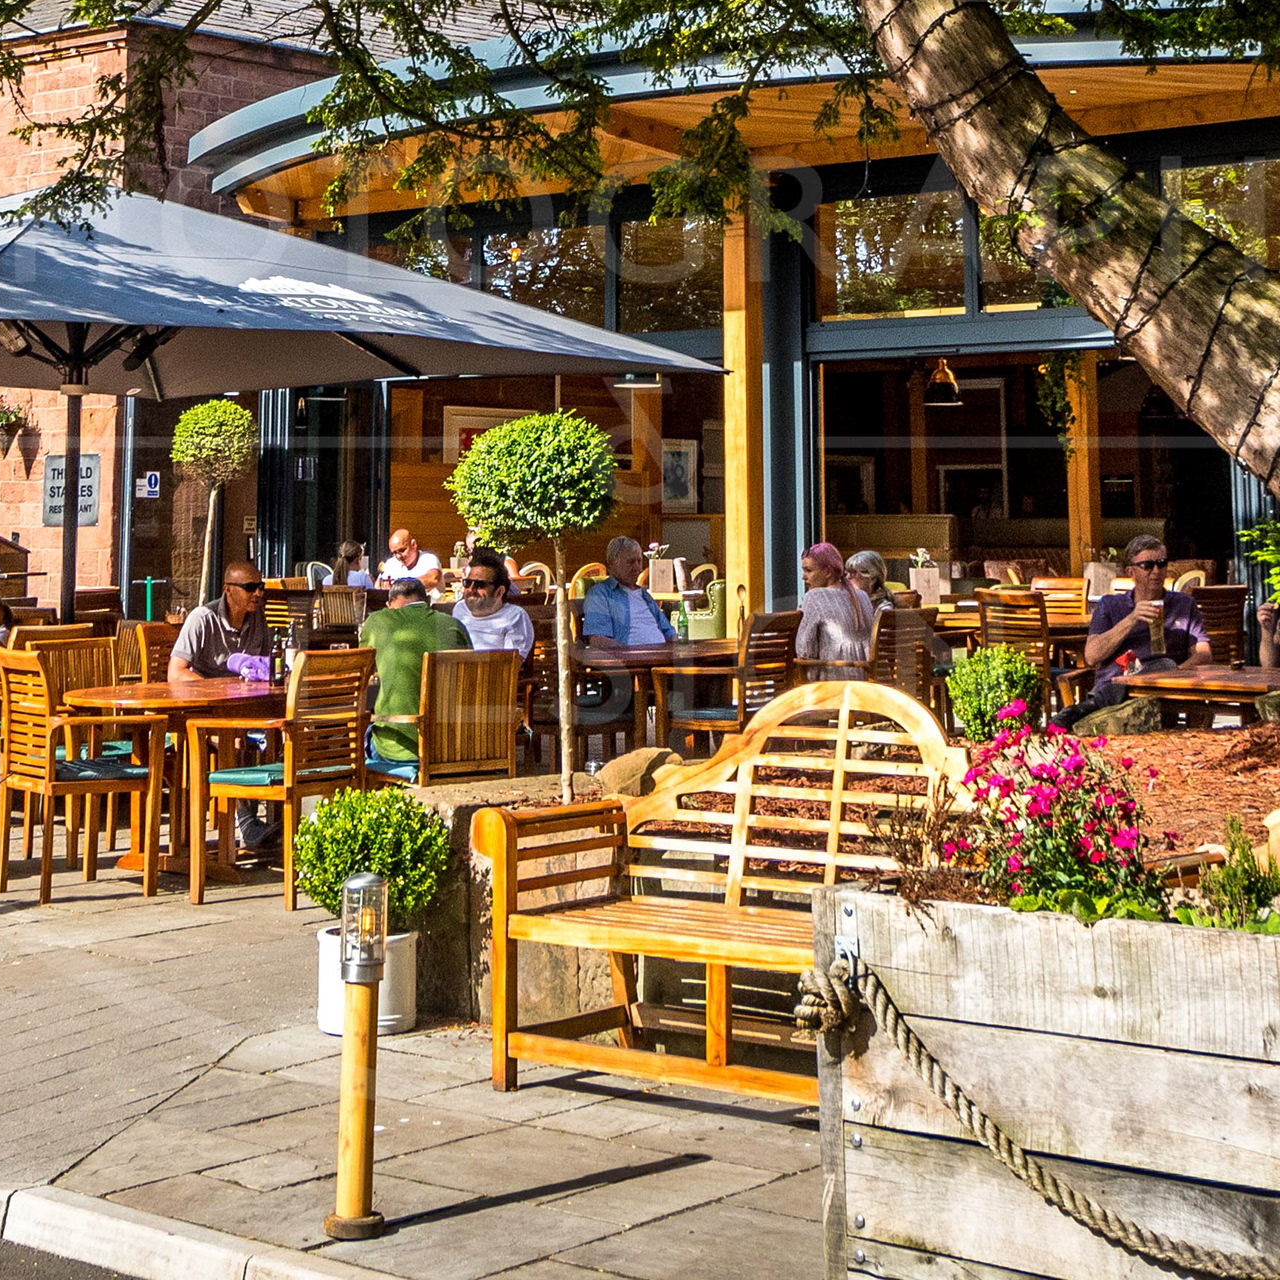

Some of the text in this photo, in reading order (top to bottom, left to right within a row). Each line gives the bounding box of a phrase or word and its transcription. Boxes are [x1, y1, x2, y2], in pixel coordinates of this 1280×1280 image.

[51, 466, 93, 480] TH LD
[49, 484, 93, 498] STAES
